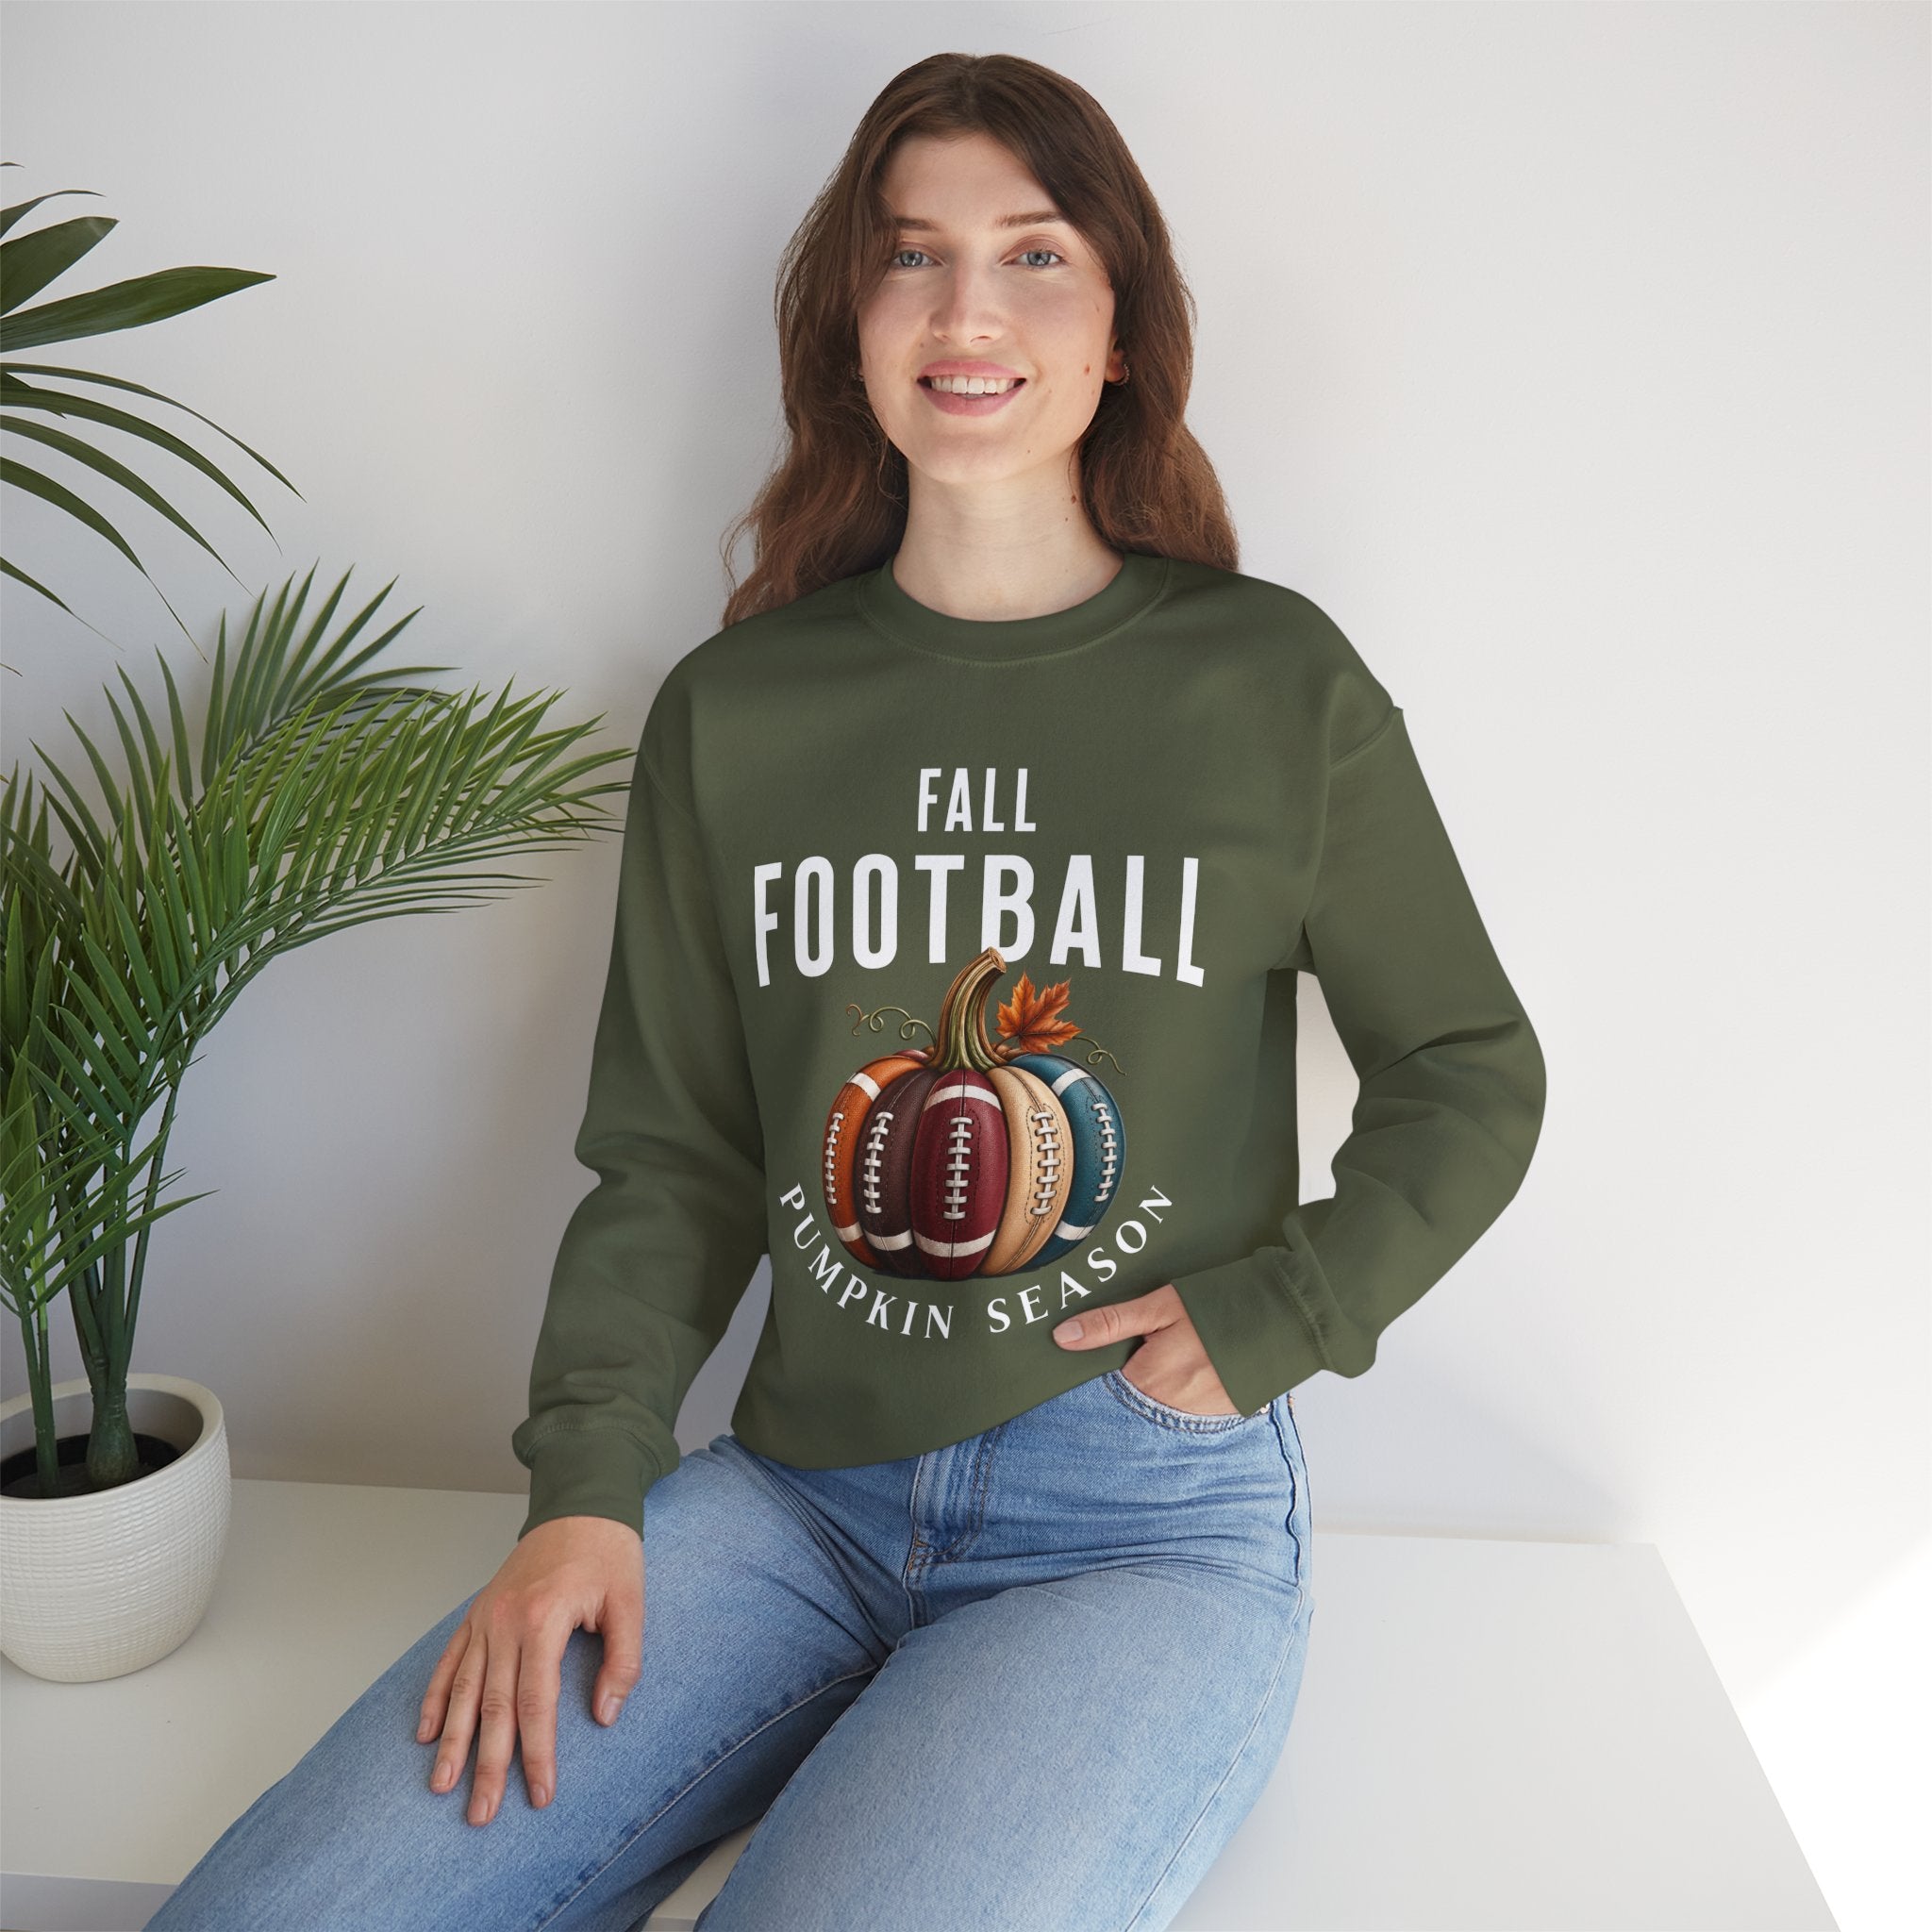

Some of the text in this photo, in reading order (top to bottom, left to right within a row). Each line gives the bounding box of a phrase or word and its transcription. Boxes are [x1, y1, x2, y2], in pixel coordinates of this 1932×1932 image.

[917, 767, 1037, 832] FALL
[754, 853, 1206, 988] FOOTBALL
[779, 1183, 1173, 1340] PUMPKIN SEASON
